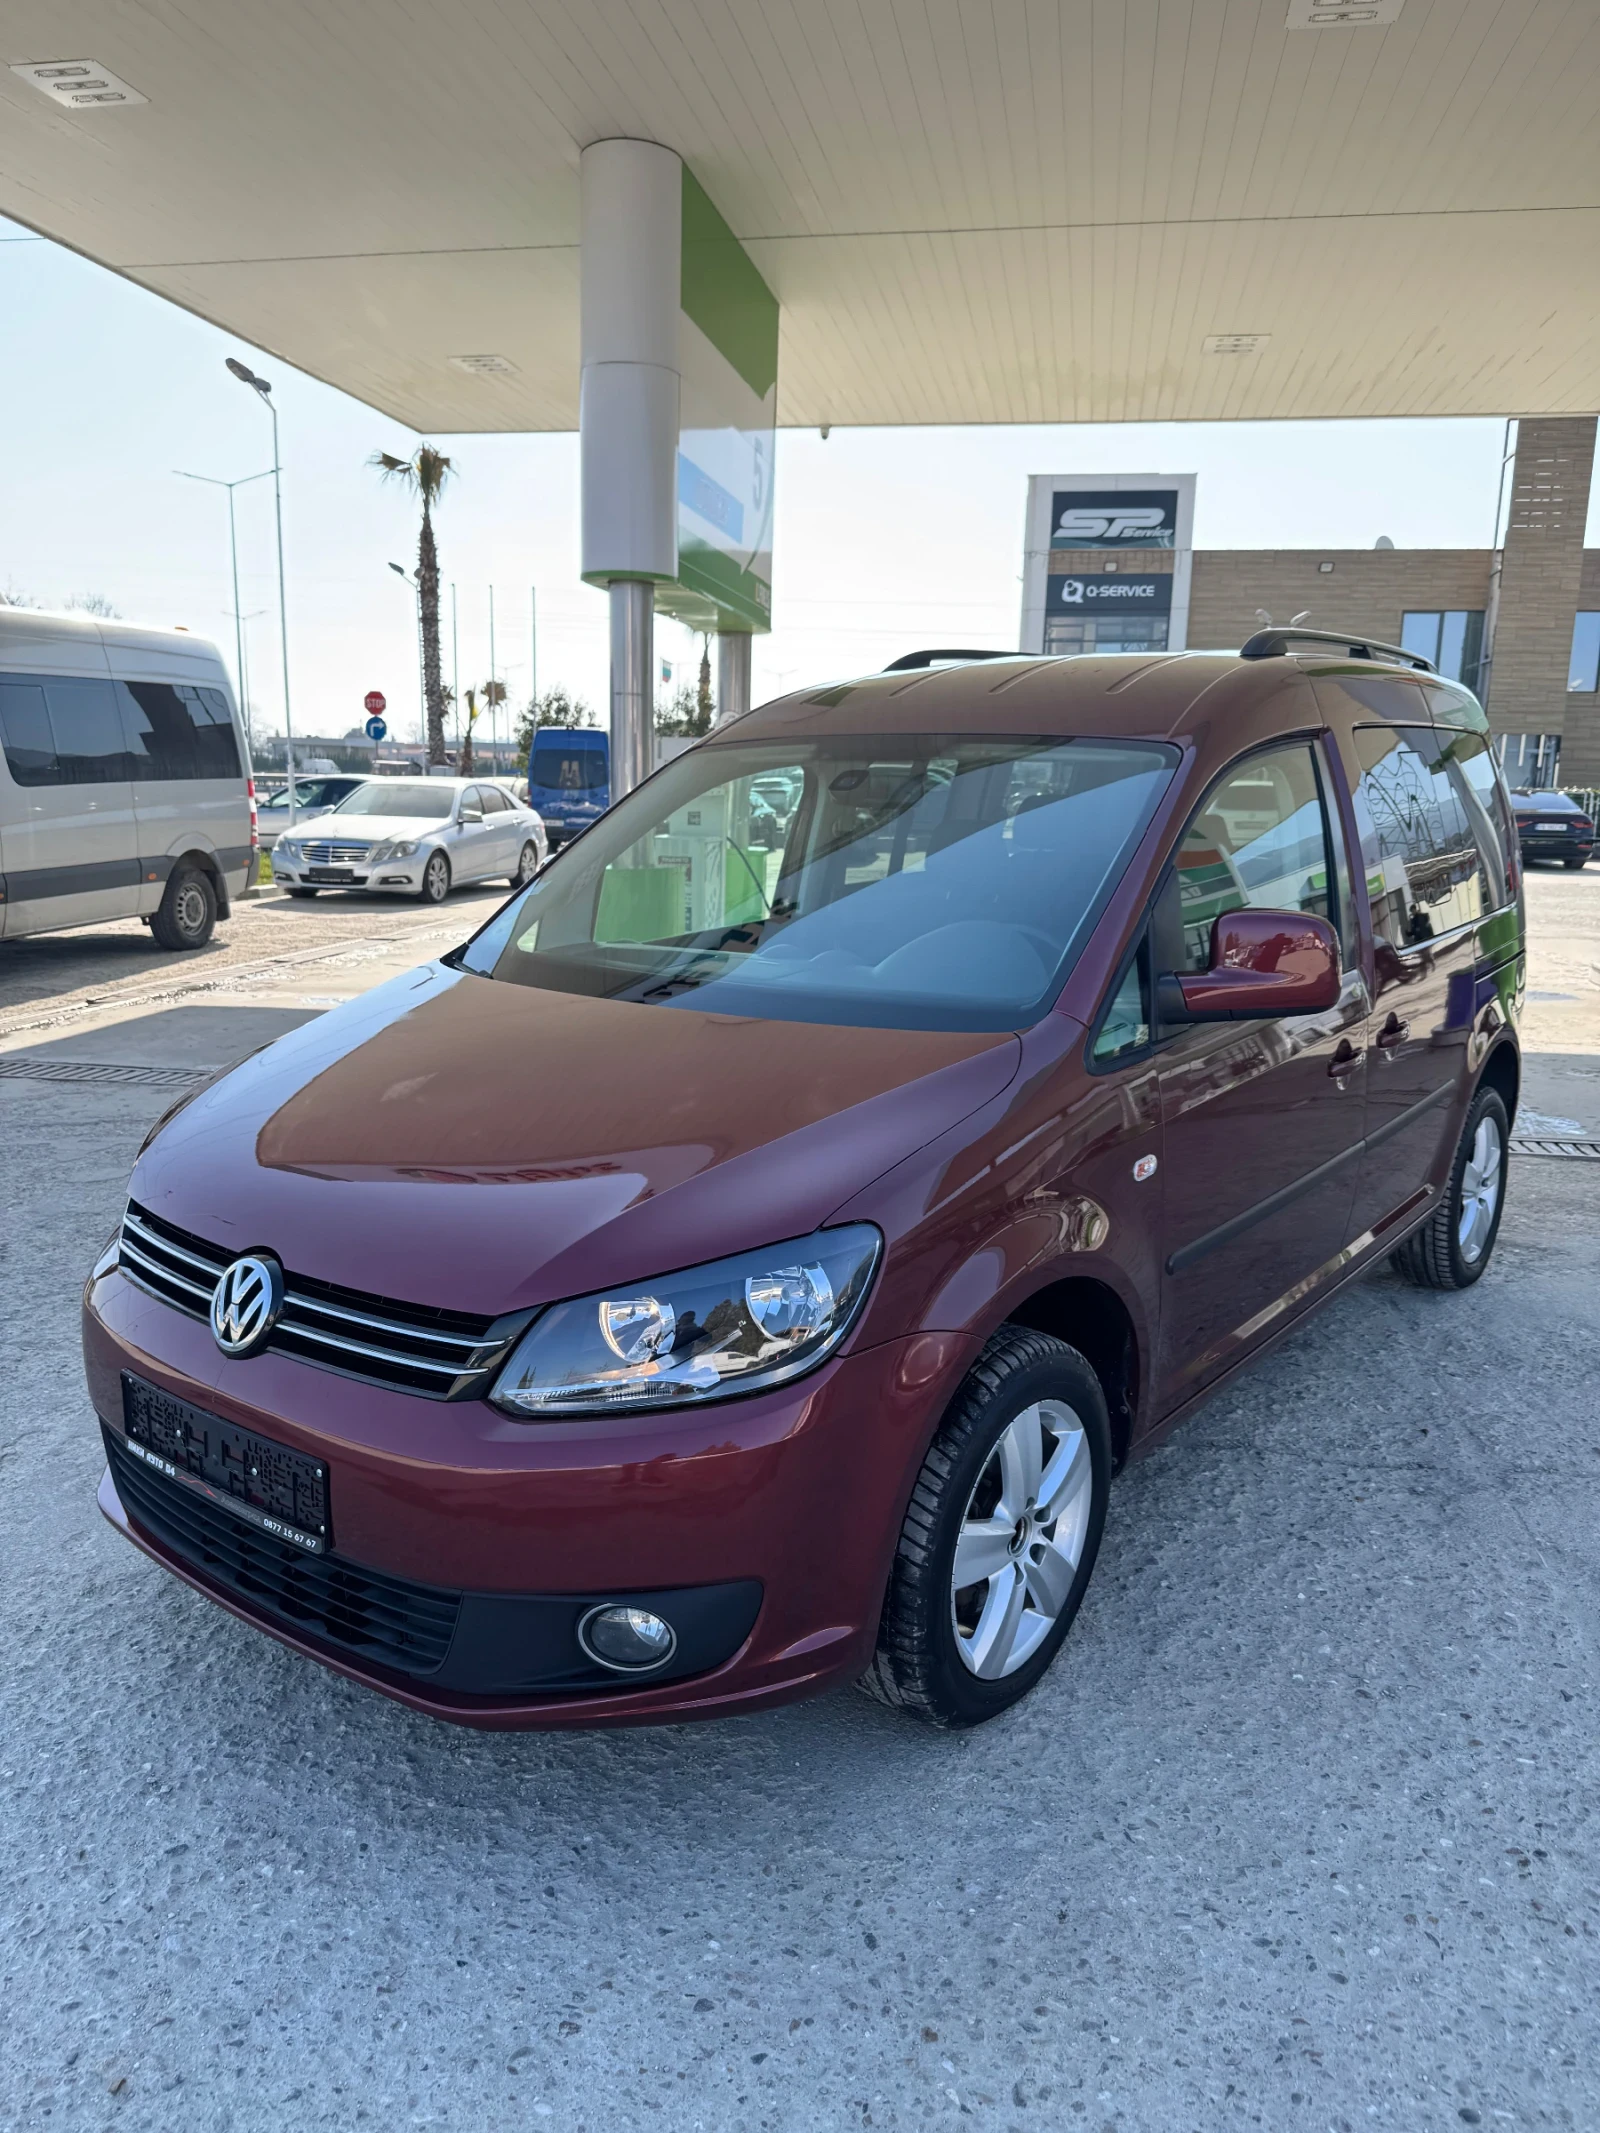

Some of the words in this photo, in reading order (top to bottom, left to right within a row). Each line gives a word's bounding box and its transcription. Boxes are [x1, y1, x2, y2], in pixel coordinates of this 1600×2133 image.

[1053, 508, 1165, 538] SP
[1086, 585, 1155, 597] Q-SERVICE
[366, 698, 386, 708] STOP
[263, 1518, 282, 1533] 0877
[283, 1527, 293, 1538] 15
[294, 1533, 304, 1543] 67
[305, 1538, 316, 1548] 67
